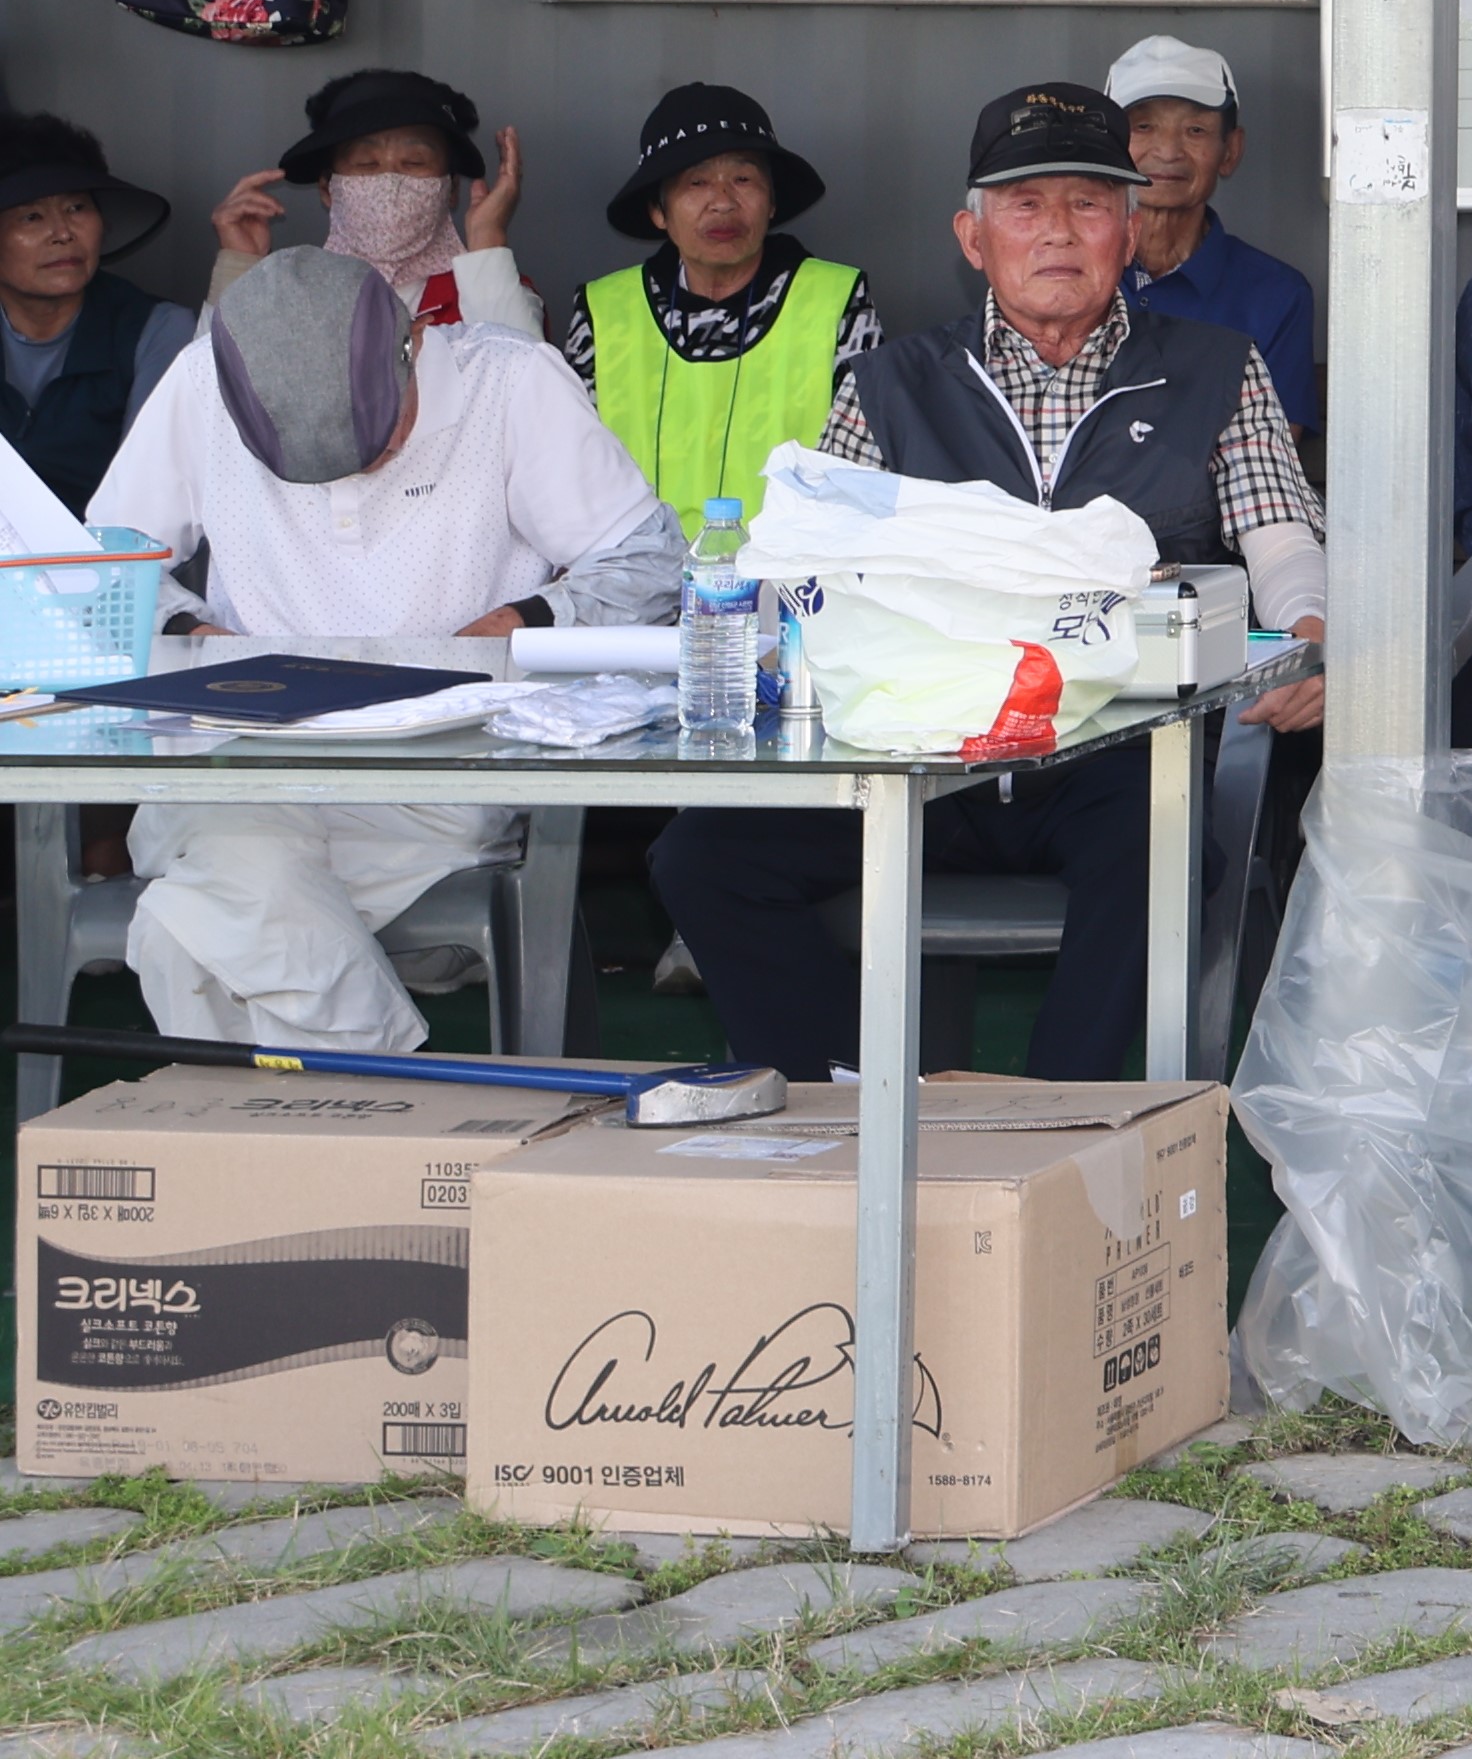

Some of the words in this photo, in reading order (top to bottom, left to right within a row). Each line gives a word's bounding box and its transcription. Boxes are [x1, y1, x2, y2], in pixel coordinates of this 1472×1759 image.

[230, 1097, 415, 1114] 크리넥스
[425, 1162, 480, 1176] 11035
[428, 1185, 468, 1203] 0203
[54, 1276, 202, 1314] 크리넥스
[80, 1318, 139, 1334] 실크소프트
[545, 1309, 717, 1431] Arnold
[63, 1402, 119, 1420] 유한킴벌리
[382, 1402, 421, 1418] 200매
[424, 1403, 436, 1418] X
[439, 1402, 462, 1419] 3입
[542, 1465, 594, 1485] 9001
[601, 1465, 685, 1487] 인증업체
[928, 1474, 992, 1486] 1588-8174
